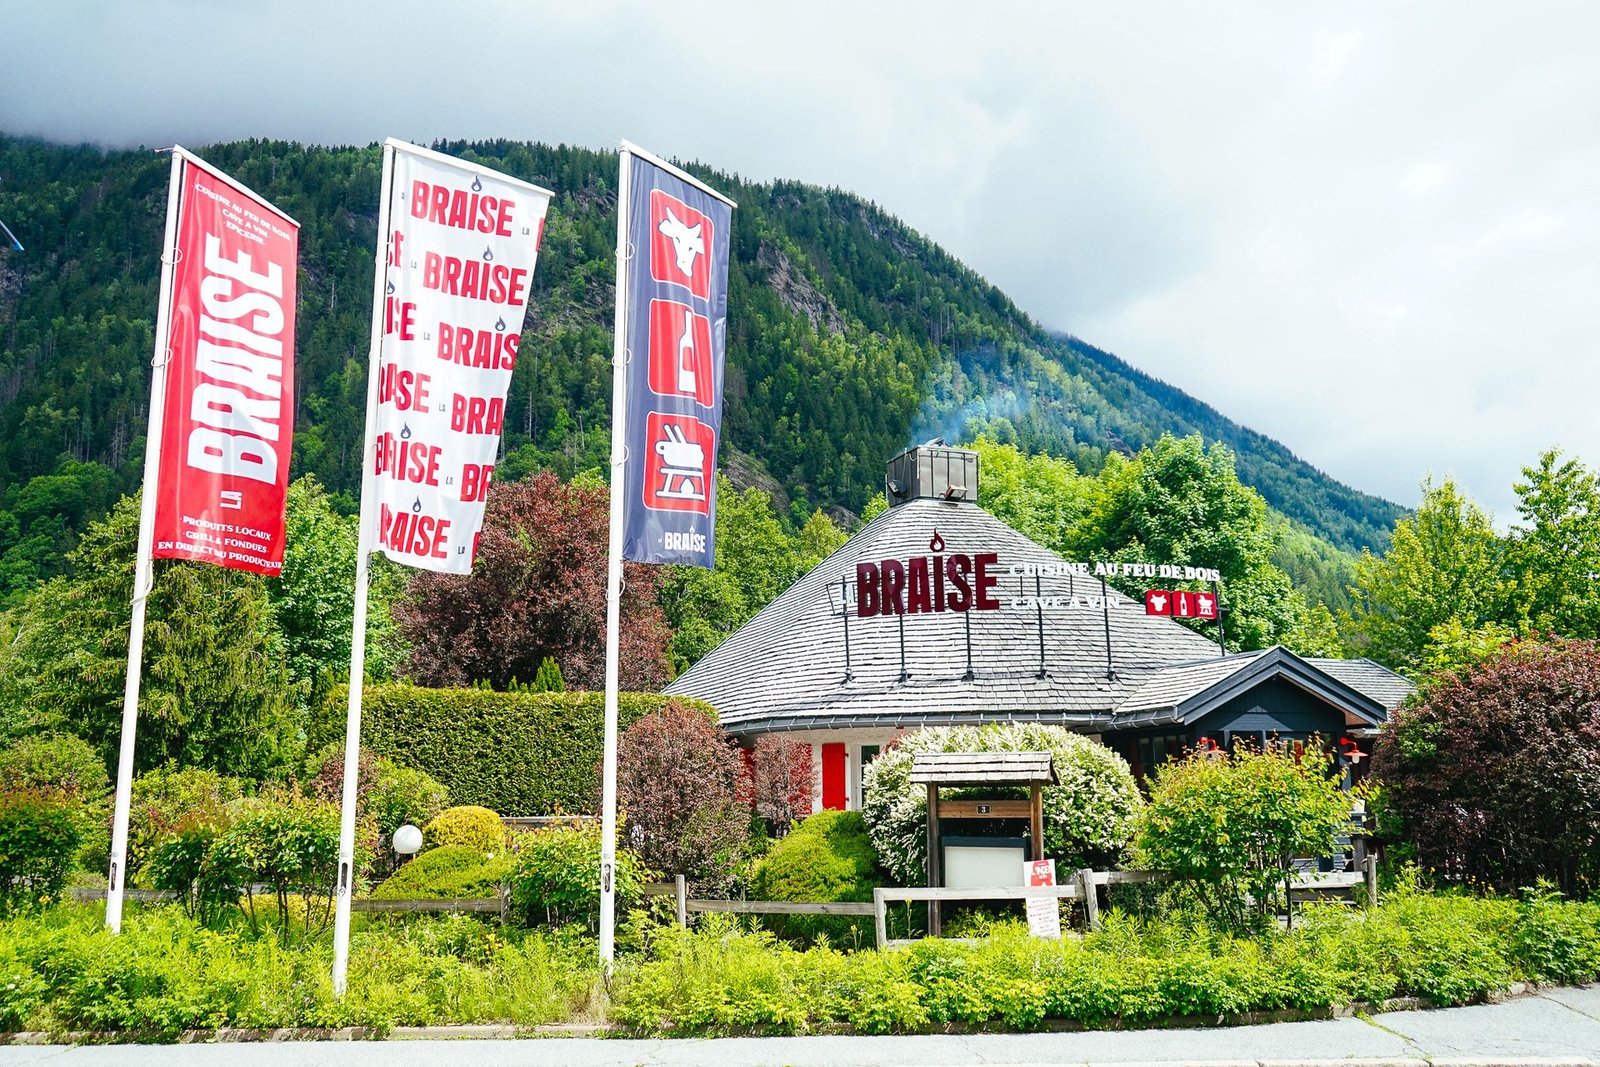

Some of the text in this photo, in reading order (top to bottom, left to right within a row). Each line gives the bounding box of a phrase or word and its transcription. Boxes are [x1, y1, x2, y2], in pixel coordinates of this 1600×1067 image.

[222, 208, 244, 225] CAVE
[243, 209, 260, 222] FEU
[260, 219, 272, 230] DE
[411, 180, 515, 237] BRAISE
[423, 251, 527, 306] BRAISE
[187, 232, 284, 485] BRAISE
[183, 515, 271, 541] PRODUITS LOCAUX
[158, 541, 173, 550] EN
[175, 541, 213, 555] DIRECT
[185, 530, 214, 543] GRILL
[224, 538, 268, 553] FONDUES
[665, 532, 706, 553] BRAISE
[1010, 562, 1221, 581] CUISINE AU FEU DE BOIS
[856, 552, 1000, 618] BRAISE
[1011, 595, 1062, 609] CAVE
[1084, 596, 1120, 609] VIN
